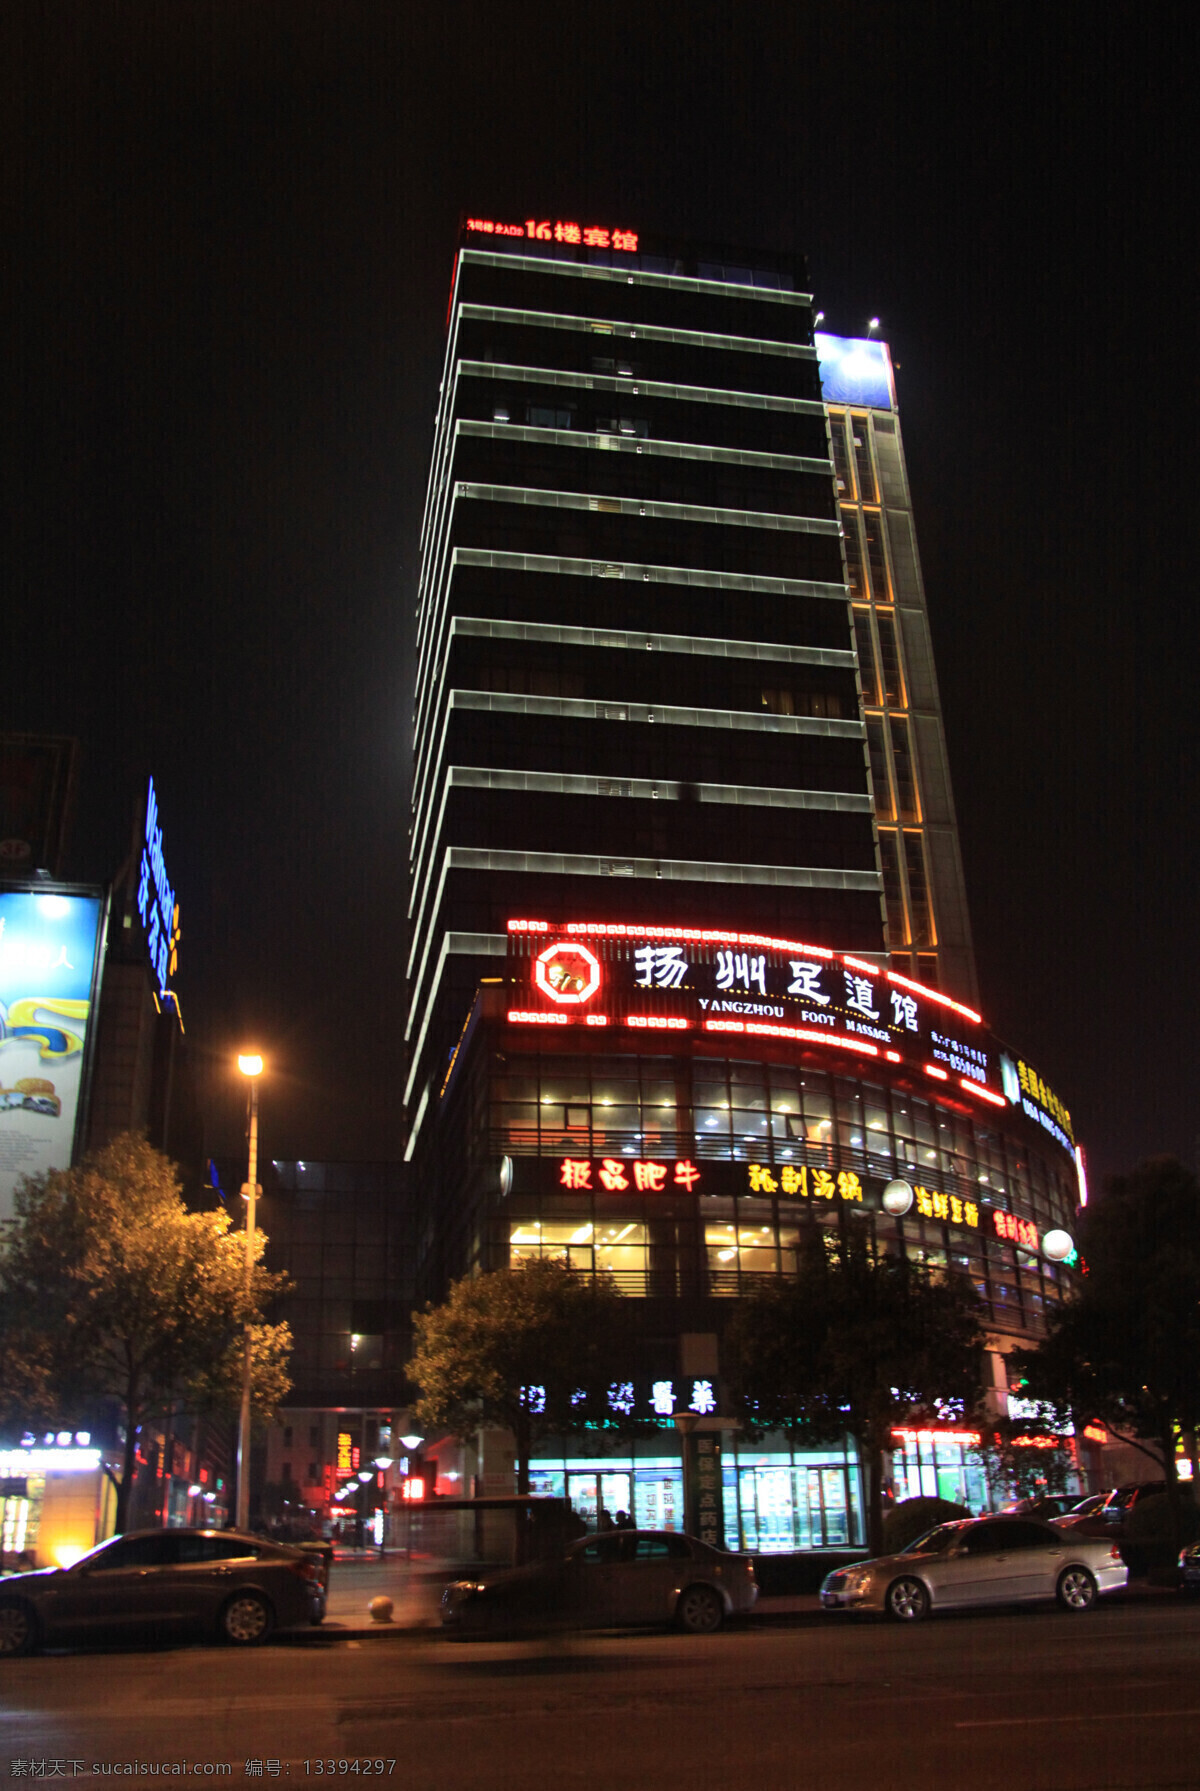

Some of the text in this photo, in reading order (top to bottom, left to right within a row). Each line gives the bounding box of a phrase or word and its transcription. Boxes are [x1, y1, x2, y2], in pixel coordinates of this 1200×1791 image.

[525, 219, 638, 252] 16楼宾馆
[634, 946, 918, 1032] 扬州足道馆
[699, 998, 891, 1043] YANGZHOU FOOT MASSAGE
[560, 1158, 700, 1192] 极品肥牛
[748, 1164, 863, 1202] 秘制汤锅
[697, 1440, 718, 1544] 医保定点药店
